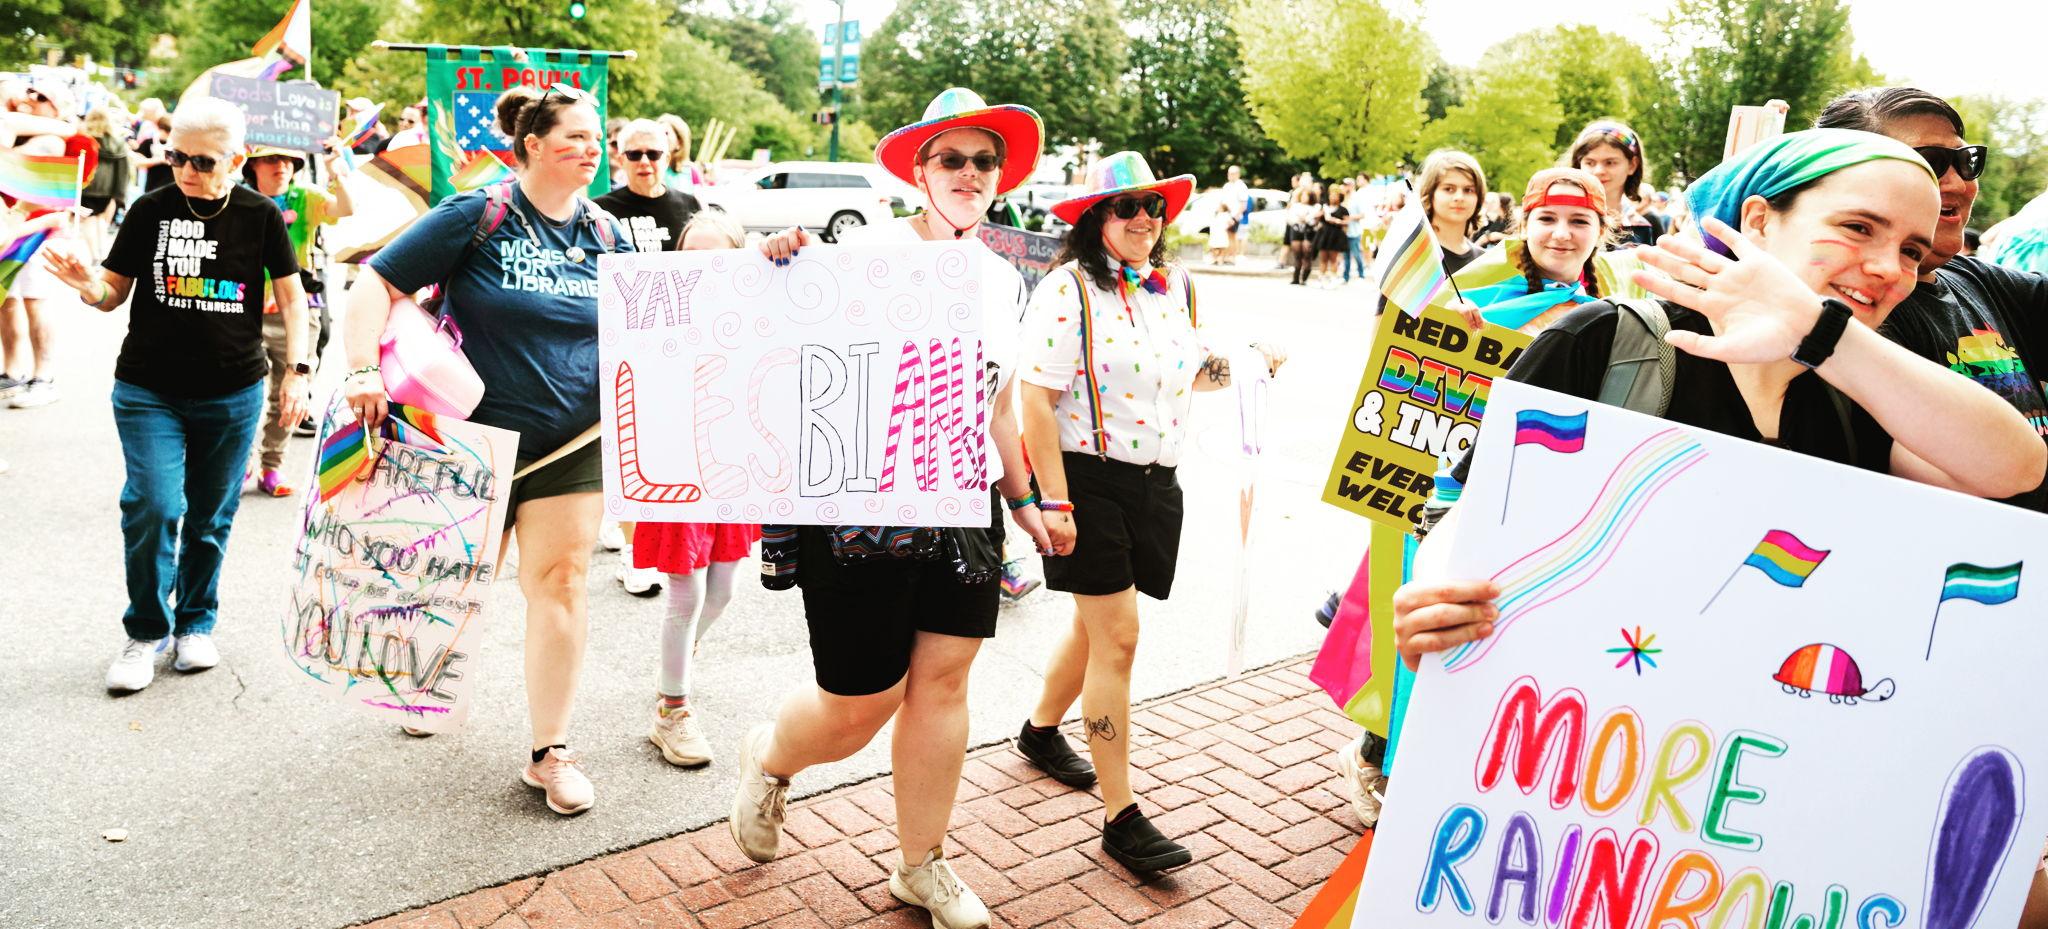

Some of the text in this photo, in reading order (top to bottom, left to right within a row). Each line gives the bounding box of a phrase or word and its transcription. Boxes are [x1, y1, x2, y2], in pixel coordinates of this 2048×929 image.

[456, 67, 491, 90] ST.
[276, 83, 316, 108] Love
[271, 110, 310, 132] than
[170, 218, 204, 239] GOD
[168, 238, 218, 260] MADE
[979, 227, 1027, 257] ESUS
[167, 257, 201, 277] YOU
[501, 257, 547, 276] FOR
[167, 276, 246, 301] FABULOUS
[613, 270, 702, 329] YAY
[168, 297, 192, 309] EAST
[1393, 310, 1468, 353] RED
[1353, 390, 1385, 437] &
[306, 513, 493, 586] WHO YOU HATE
[292, 585, 469, 704] YOU LOVE
[1475, 675, 1788, 852] MORE
